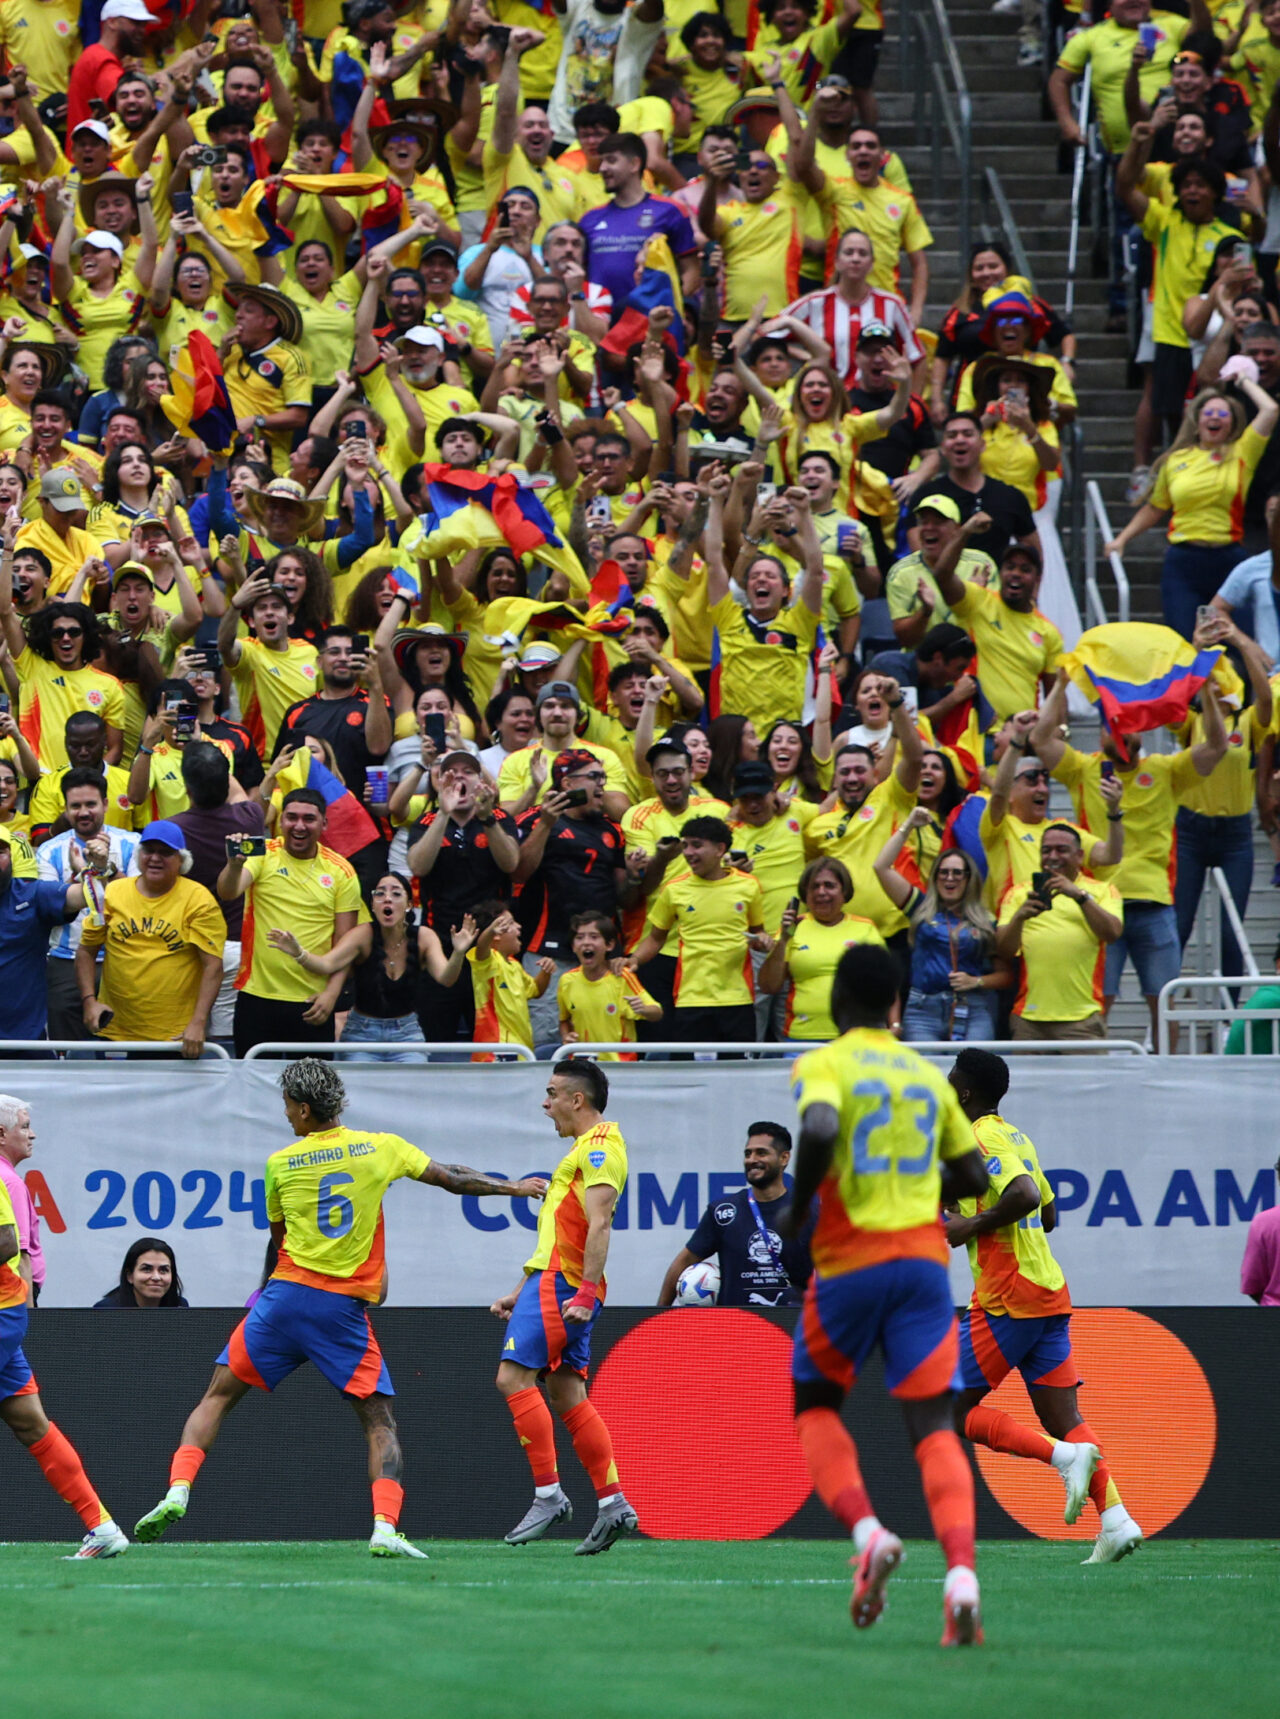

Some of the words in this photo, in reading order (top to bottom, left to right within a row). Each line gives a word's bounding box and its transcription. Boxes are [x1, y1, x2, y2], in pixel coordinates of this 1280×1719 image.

[582, 848, 598, 874] 7
[111, 916, 185, 952] CHAMPION
[852, 1079, 937, 1174] 23
[288, 1147, 344, 1170] RICHARD
[348, 1142, 376, 1158] RIOS
[84, 1169, 270, 1230] 2024
[317, 1172, 355, 1239] 6
[716, 1208, 735, 1220] 165
